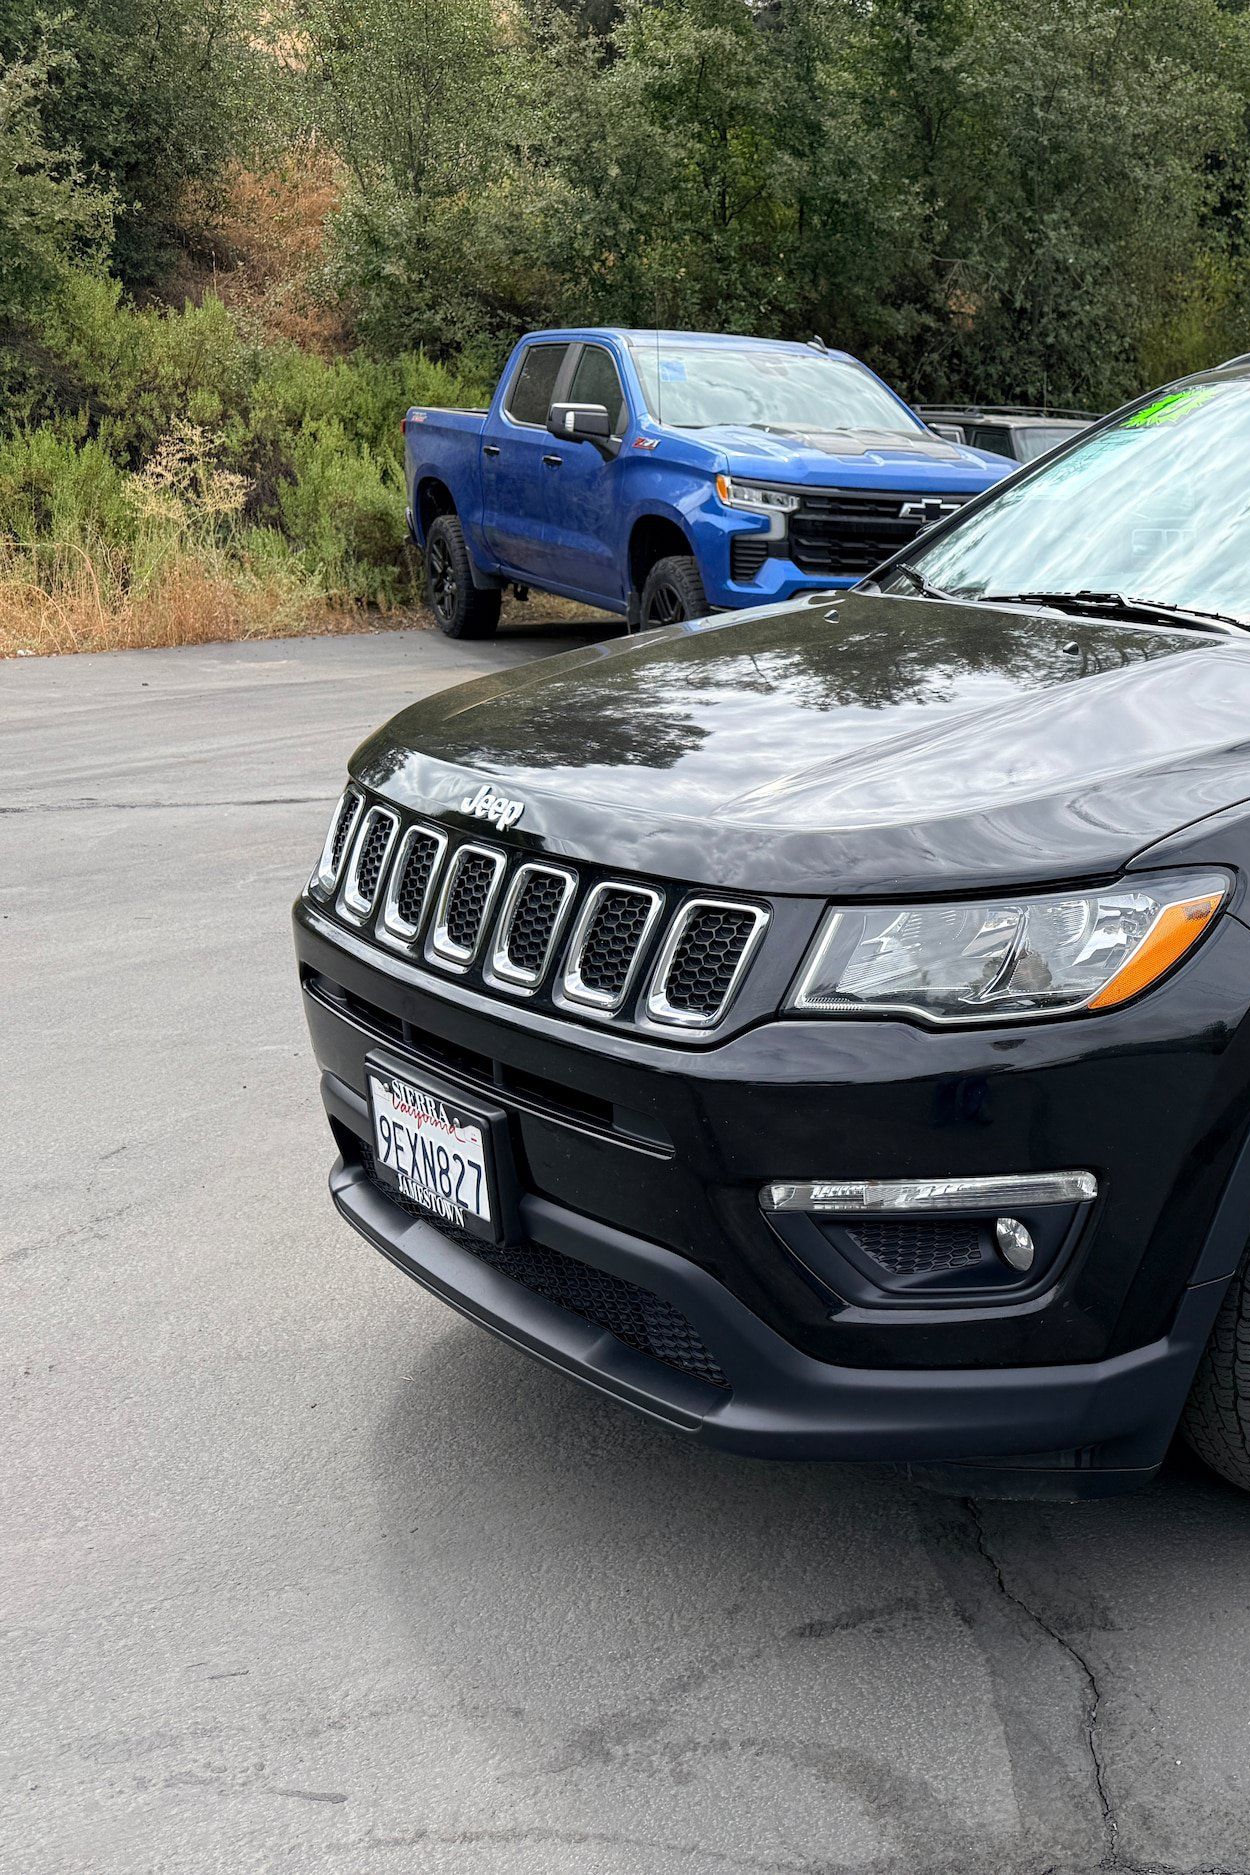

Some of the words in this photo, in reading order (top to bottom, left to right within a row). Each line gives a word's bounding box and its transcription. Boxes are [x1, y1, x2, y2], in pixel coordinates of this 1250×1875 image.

[460, 784, 525, 832] Jeep
[392, 1079, 451, 1126] SIERRA
[379, 1114, 482, 1215] 9EXN827
[397, 1174, 465, 1227] JAMESTOWN
